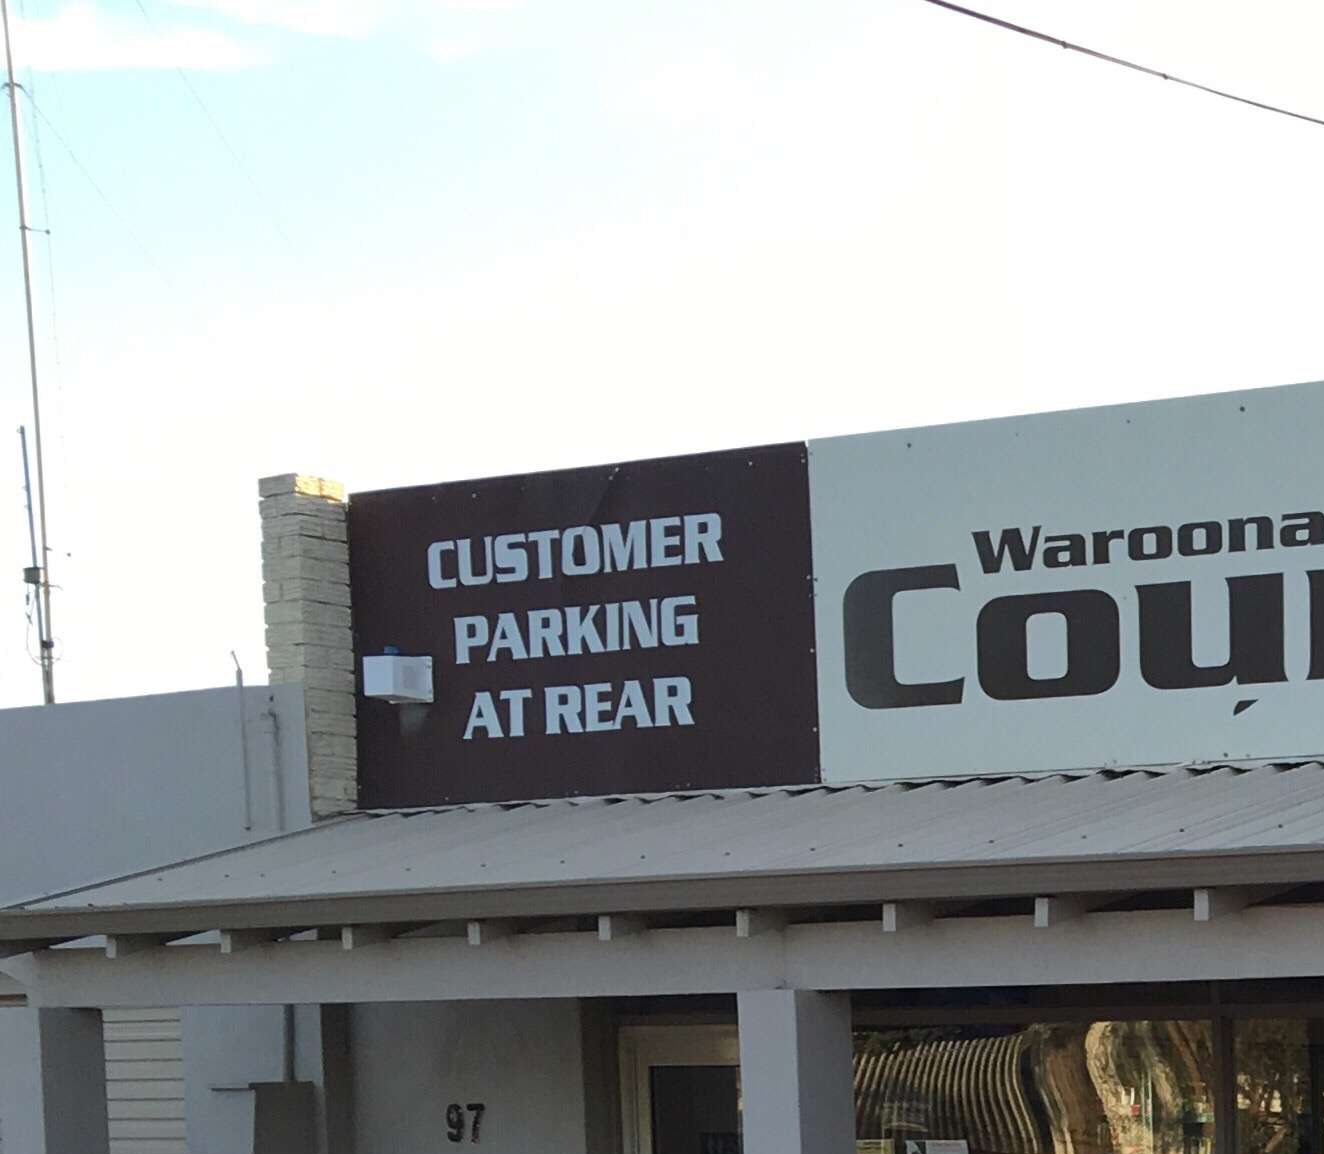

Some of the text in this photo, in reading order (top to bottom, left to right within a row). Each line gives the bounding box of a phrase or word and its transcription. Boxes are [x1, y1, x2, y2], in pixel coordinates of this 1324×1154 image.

[428, 513, 723, 589] CUSTOMER
[454, 596, 699, 664] PARKING
[463, 677, 694, 739] AT REAR
[446, 1103, 485, 1143] 97
